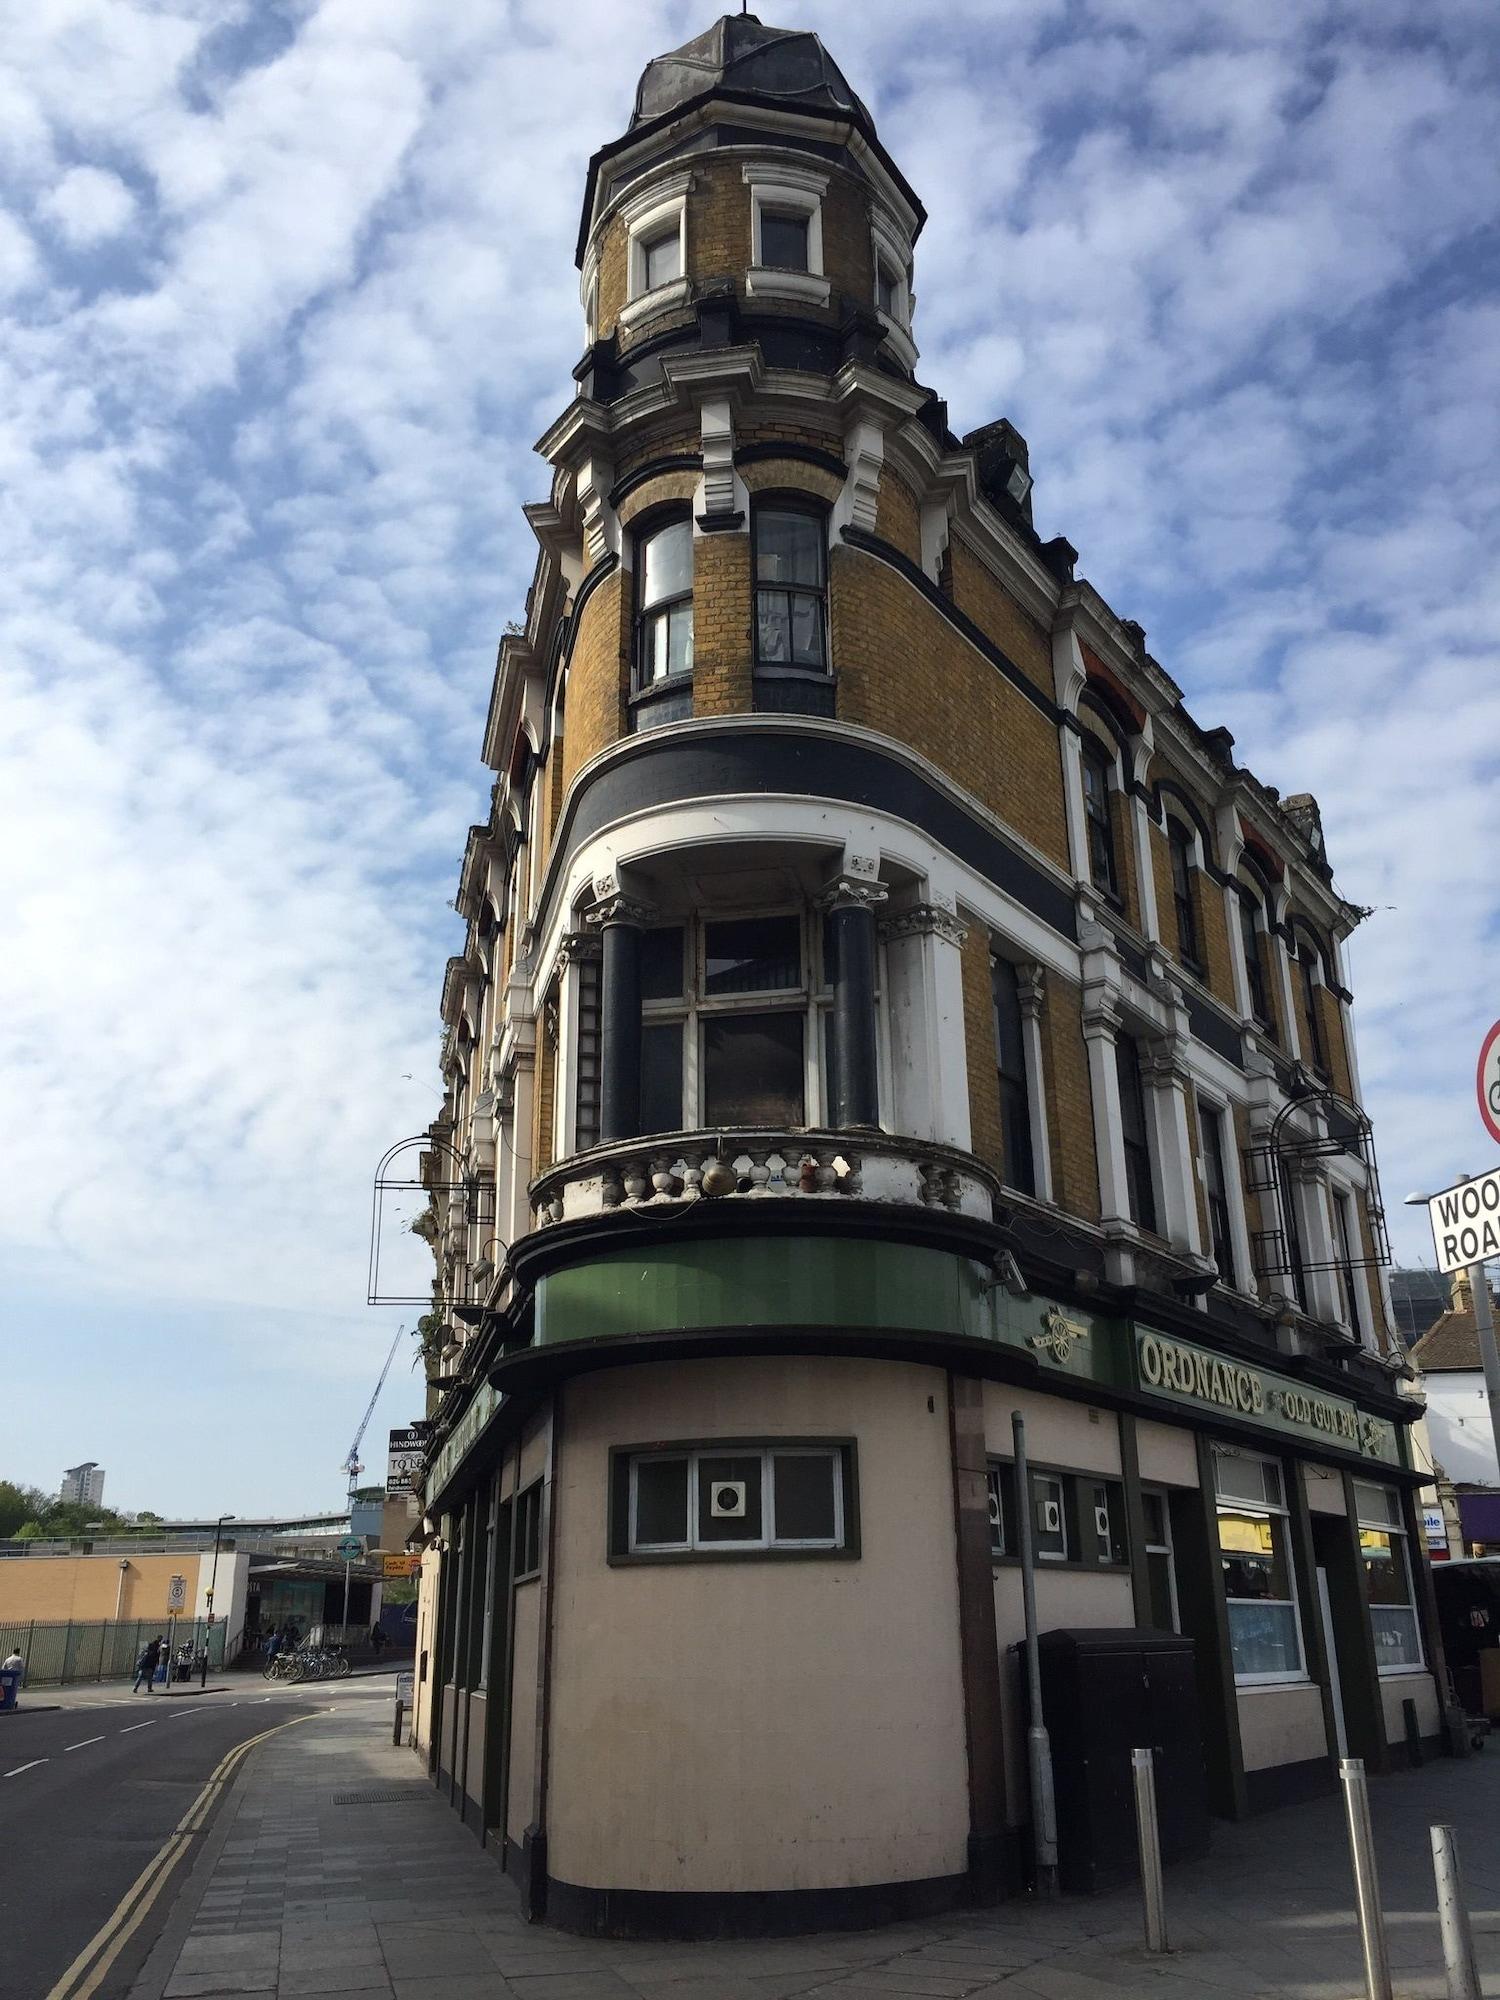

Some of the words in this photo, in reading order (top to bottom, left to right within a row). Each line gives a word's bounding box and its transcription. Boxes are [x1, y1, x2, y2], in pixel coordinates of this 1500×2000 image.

[1438, 1174, 1500, 1228] WOO
[1443, 1216, 1500, 1266] ROA
[1142, 1334, 1265, 1415] ORDNANCE
[1285, 1391, 1312, 1424] OLD
[1313, 1400, 1338, 1433] GUN
[391, 1459, 407, 1470] TO
[410, 1458, 424, 1469] LE
